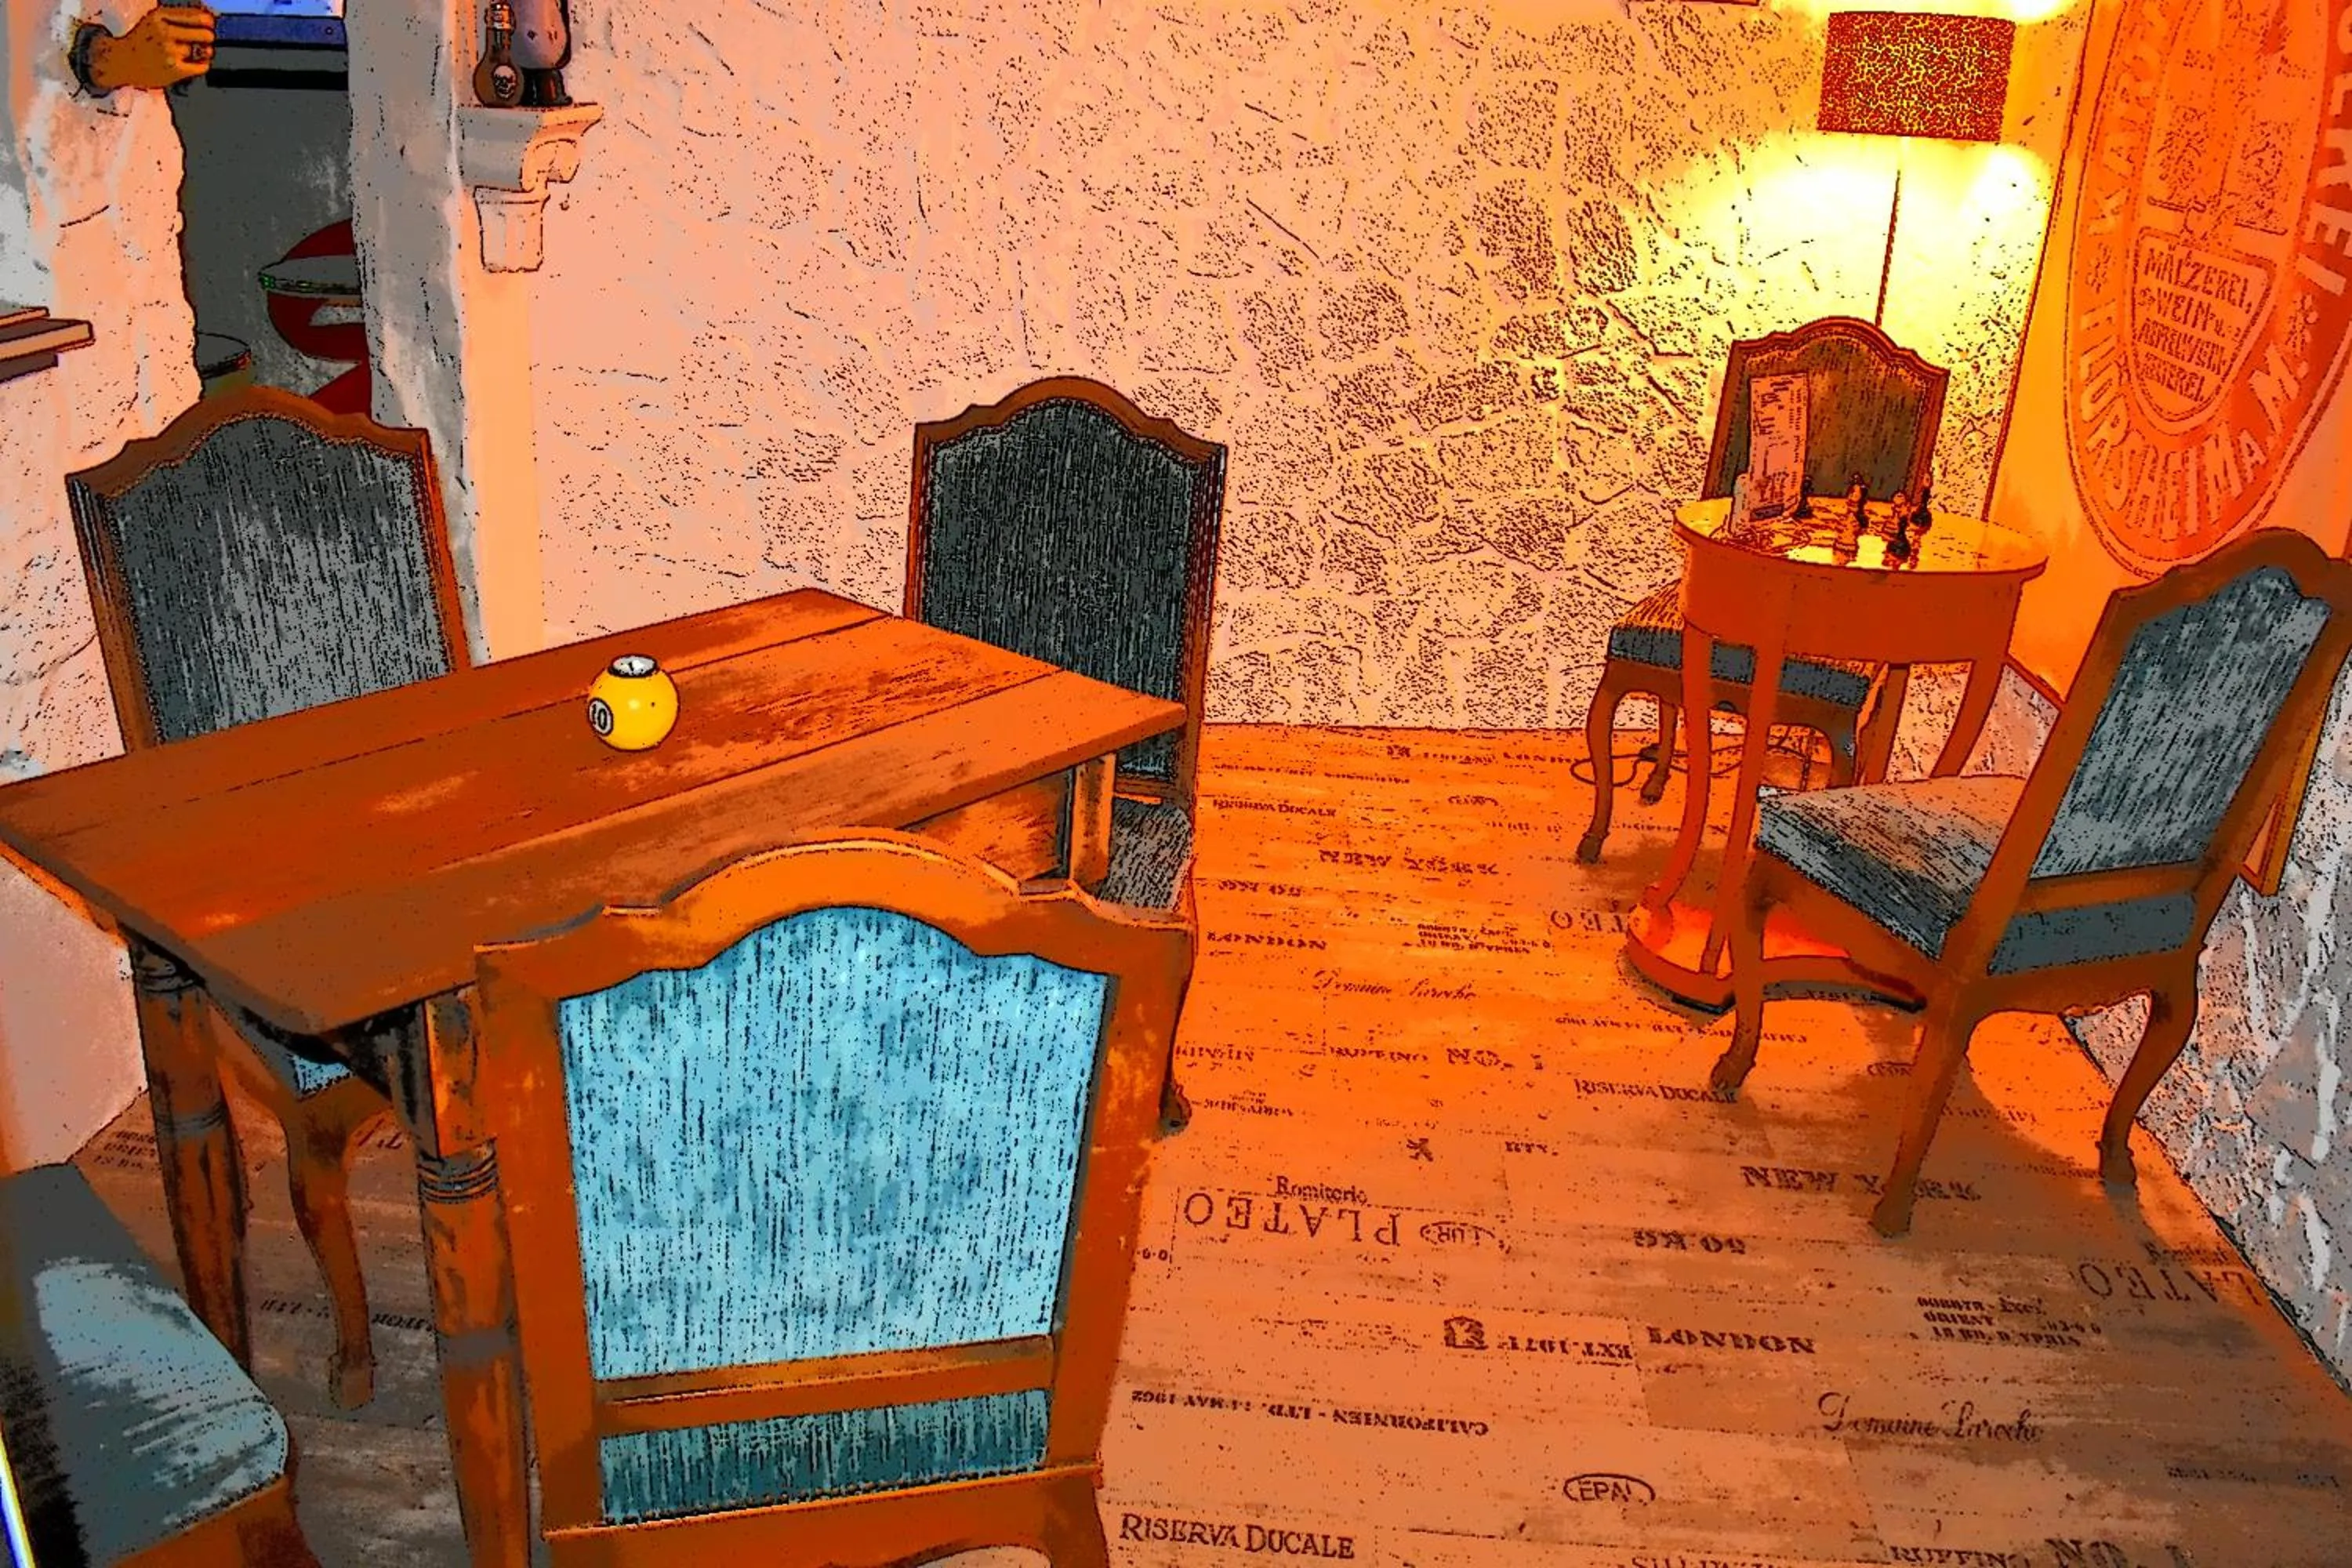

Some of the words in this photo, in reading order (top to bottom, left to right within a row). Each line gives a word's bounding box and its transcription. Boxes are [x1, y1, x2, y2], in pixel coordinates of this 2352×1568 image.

[1183, 1192, 1400, 1247] PLATEO
[1646, 1326, 1816, 1355] LONDON
[1331, 1406, 1490, 1437] CALIFORNIEN
[1120, 1512, 1240, 1549] RISERVA
[1243, 1523, 1356, 1560] DUCALE
